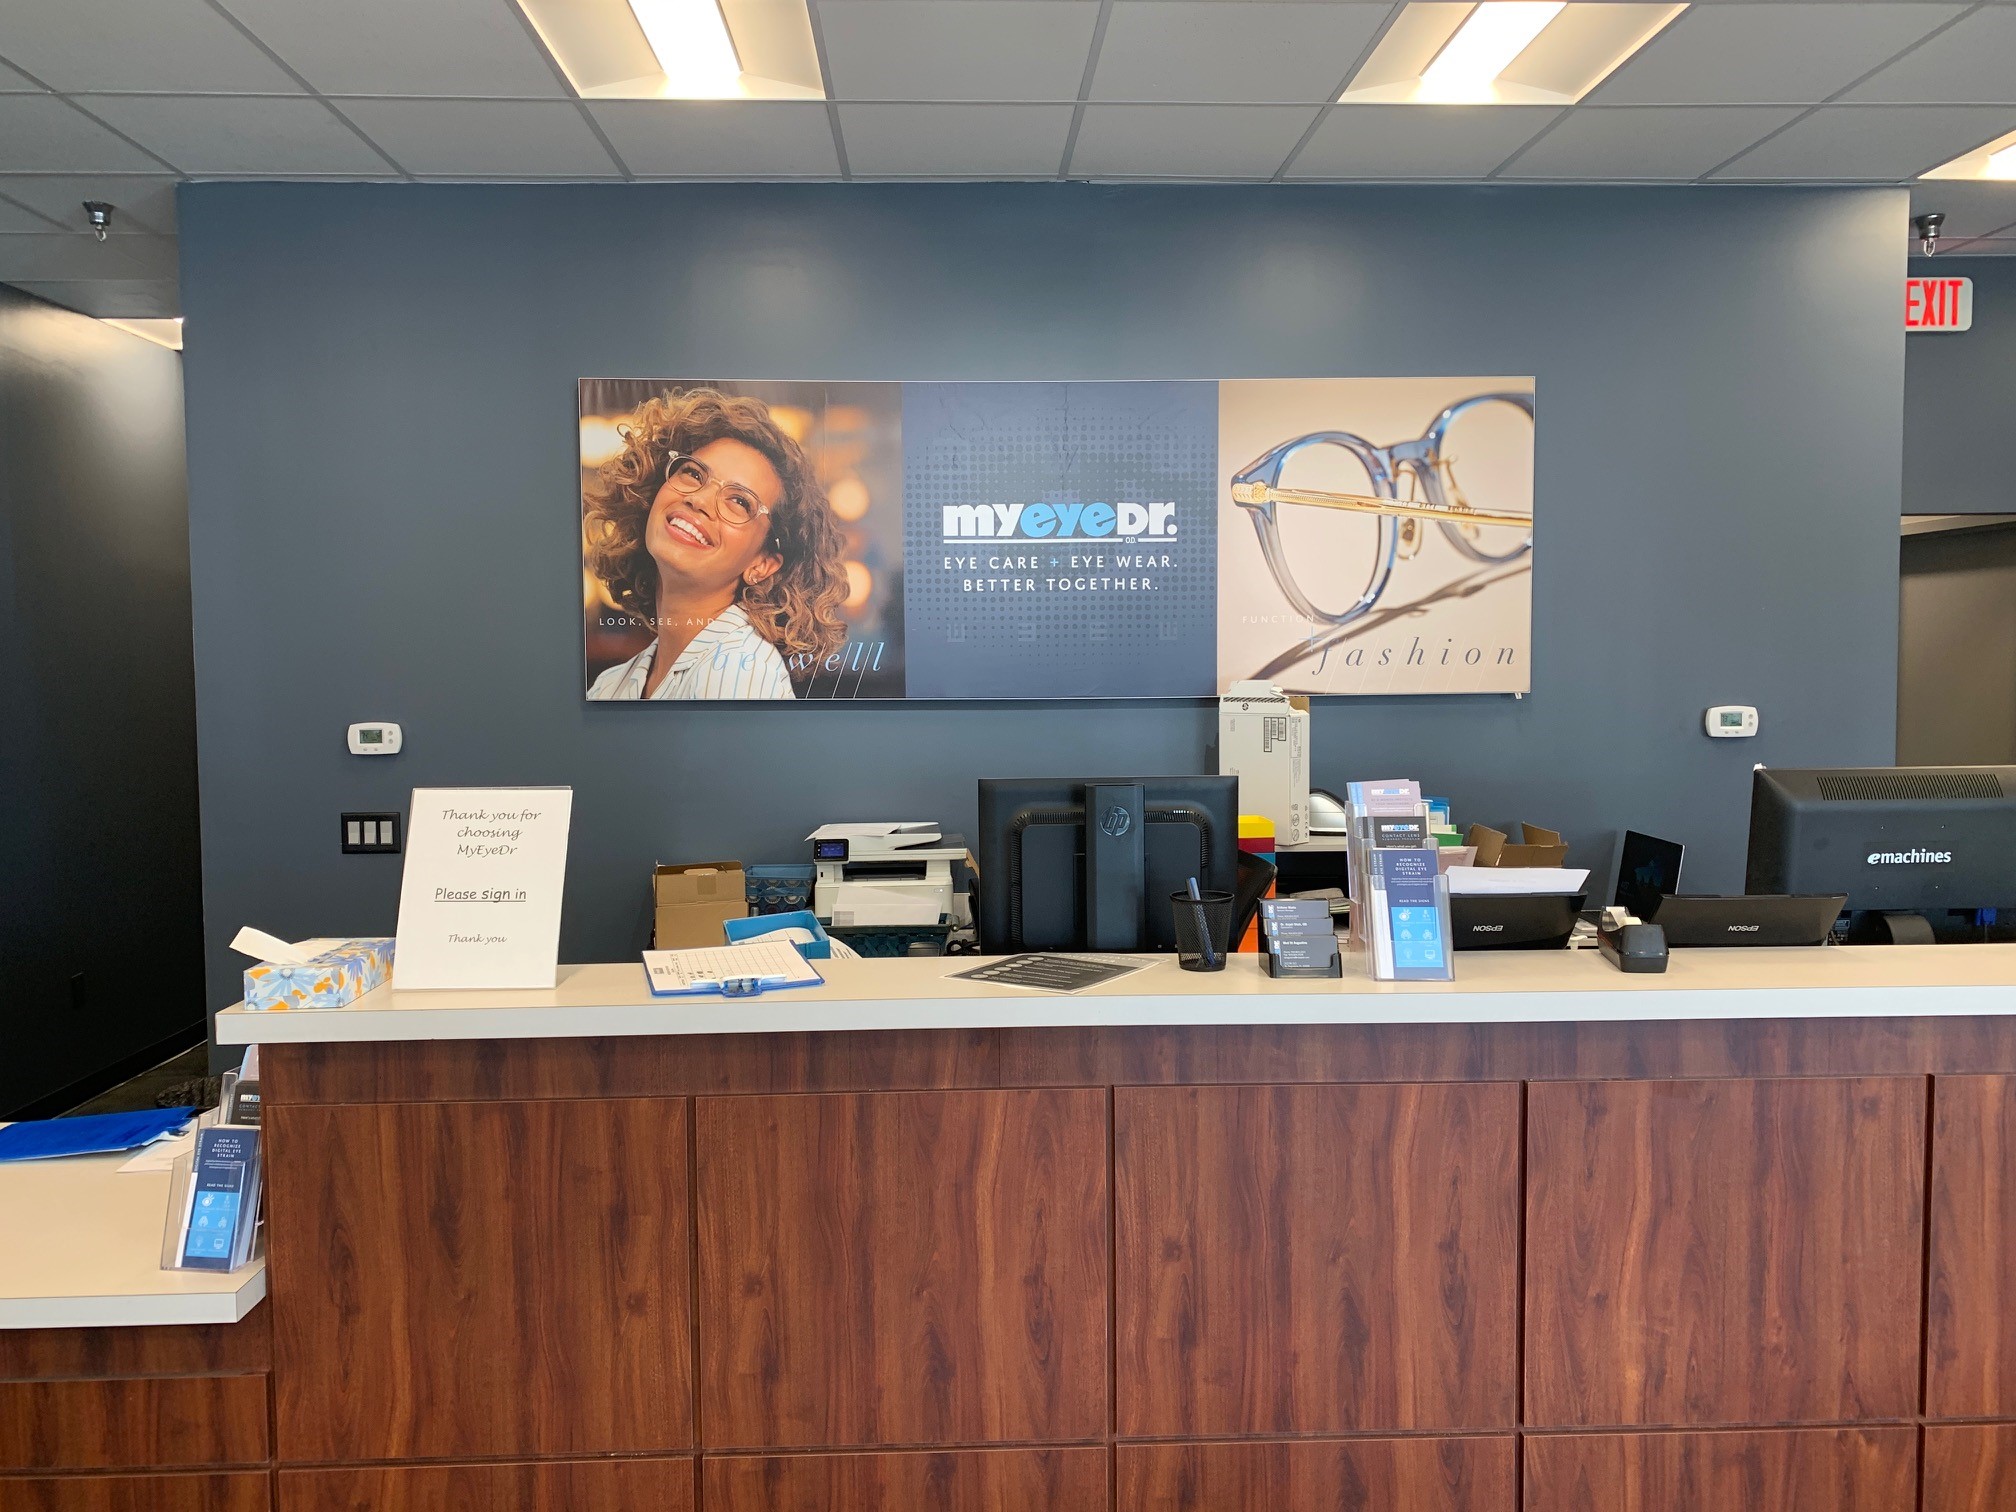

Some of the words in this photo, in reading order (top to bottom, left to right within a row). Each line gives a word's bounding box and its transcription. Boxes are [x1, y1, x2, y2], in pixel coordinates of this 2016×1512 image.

[1905, 280, 1963, 326] EXIT
[944, 557, 978, 569] EYE
[989, 556, 1039, 569] CARE
[1071, 555, 1105, 568] EYE
[1116, 555, 1178, 568] WEAR.
[963, 578, 1036, 592] BETTER
[1046, 577, 1159, 591] TOGETHER.
[599, 617, 642, 627] LOOK,
[649, 617, 678, 627] SEE,
[686, 617, 716, 626] AND
[1242, 614, 1314, 624] FUNCTION
[712, 643, 757, 672] be
[788, 642, 885, 672] well
[1312, 637, 1515, 676] fashion
[442, 809, 489, 821] Thank
[489, 812, 519, 823] you
[519, 808, 542, 823] for
[457, 827, 523, 841] choosing
[456, 845, 518, 858] MyEyeDr
[1867, 848, 1951, 865] emachines
[435, 888, 477, 901] Please
[481, 888, 511, 903] sign
[515, 888, 527, 901] in
[448, 934, 485, 943] Thank
[484, 936, 508, 945] you
